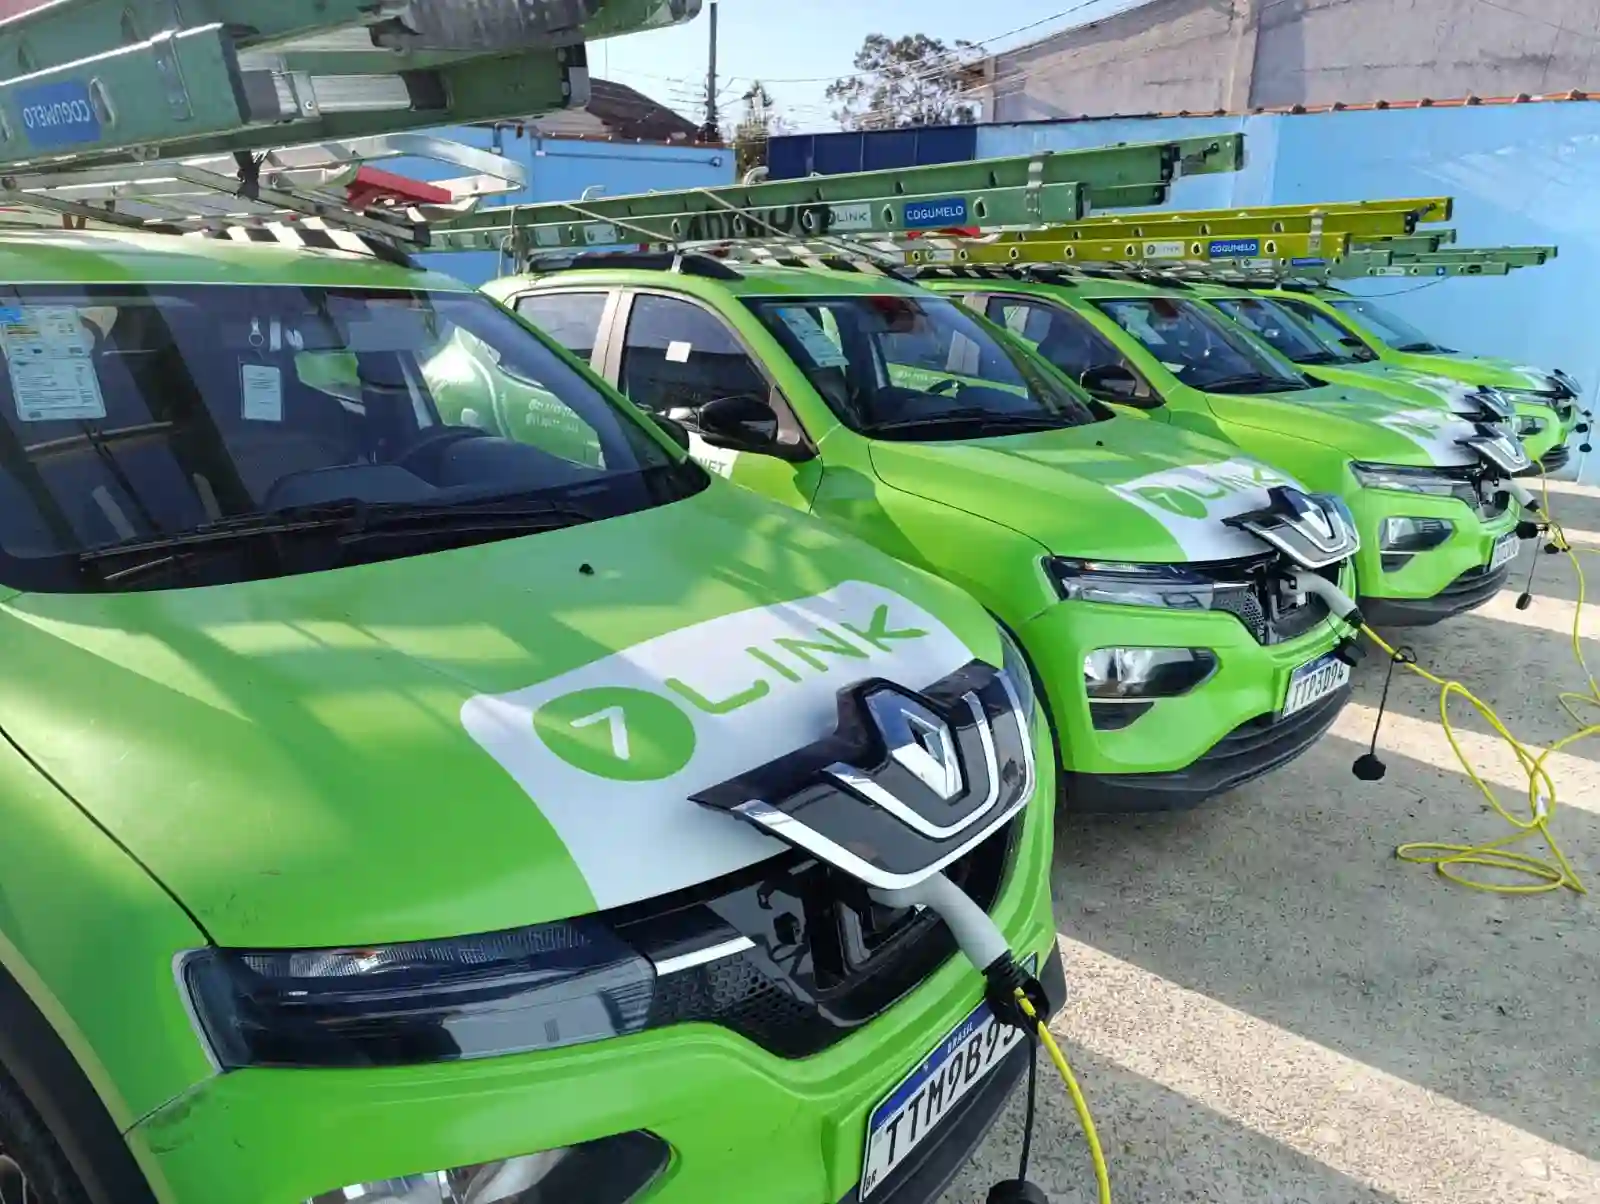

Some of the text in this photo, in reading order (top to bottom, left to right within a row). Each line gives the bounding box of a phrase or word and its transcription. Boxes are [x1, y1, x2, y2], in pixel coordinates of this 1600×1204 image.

[23, 99, 90, 129] COGUMELO
[837, 211, 868, 222] LINK
[906, 205, 964, 220] COGUMELO
[664, 604, 930, 714] LINK
[947, 1021, 975, 1056] BRASIL
